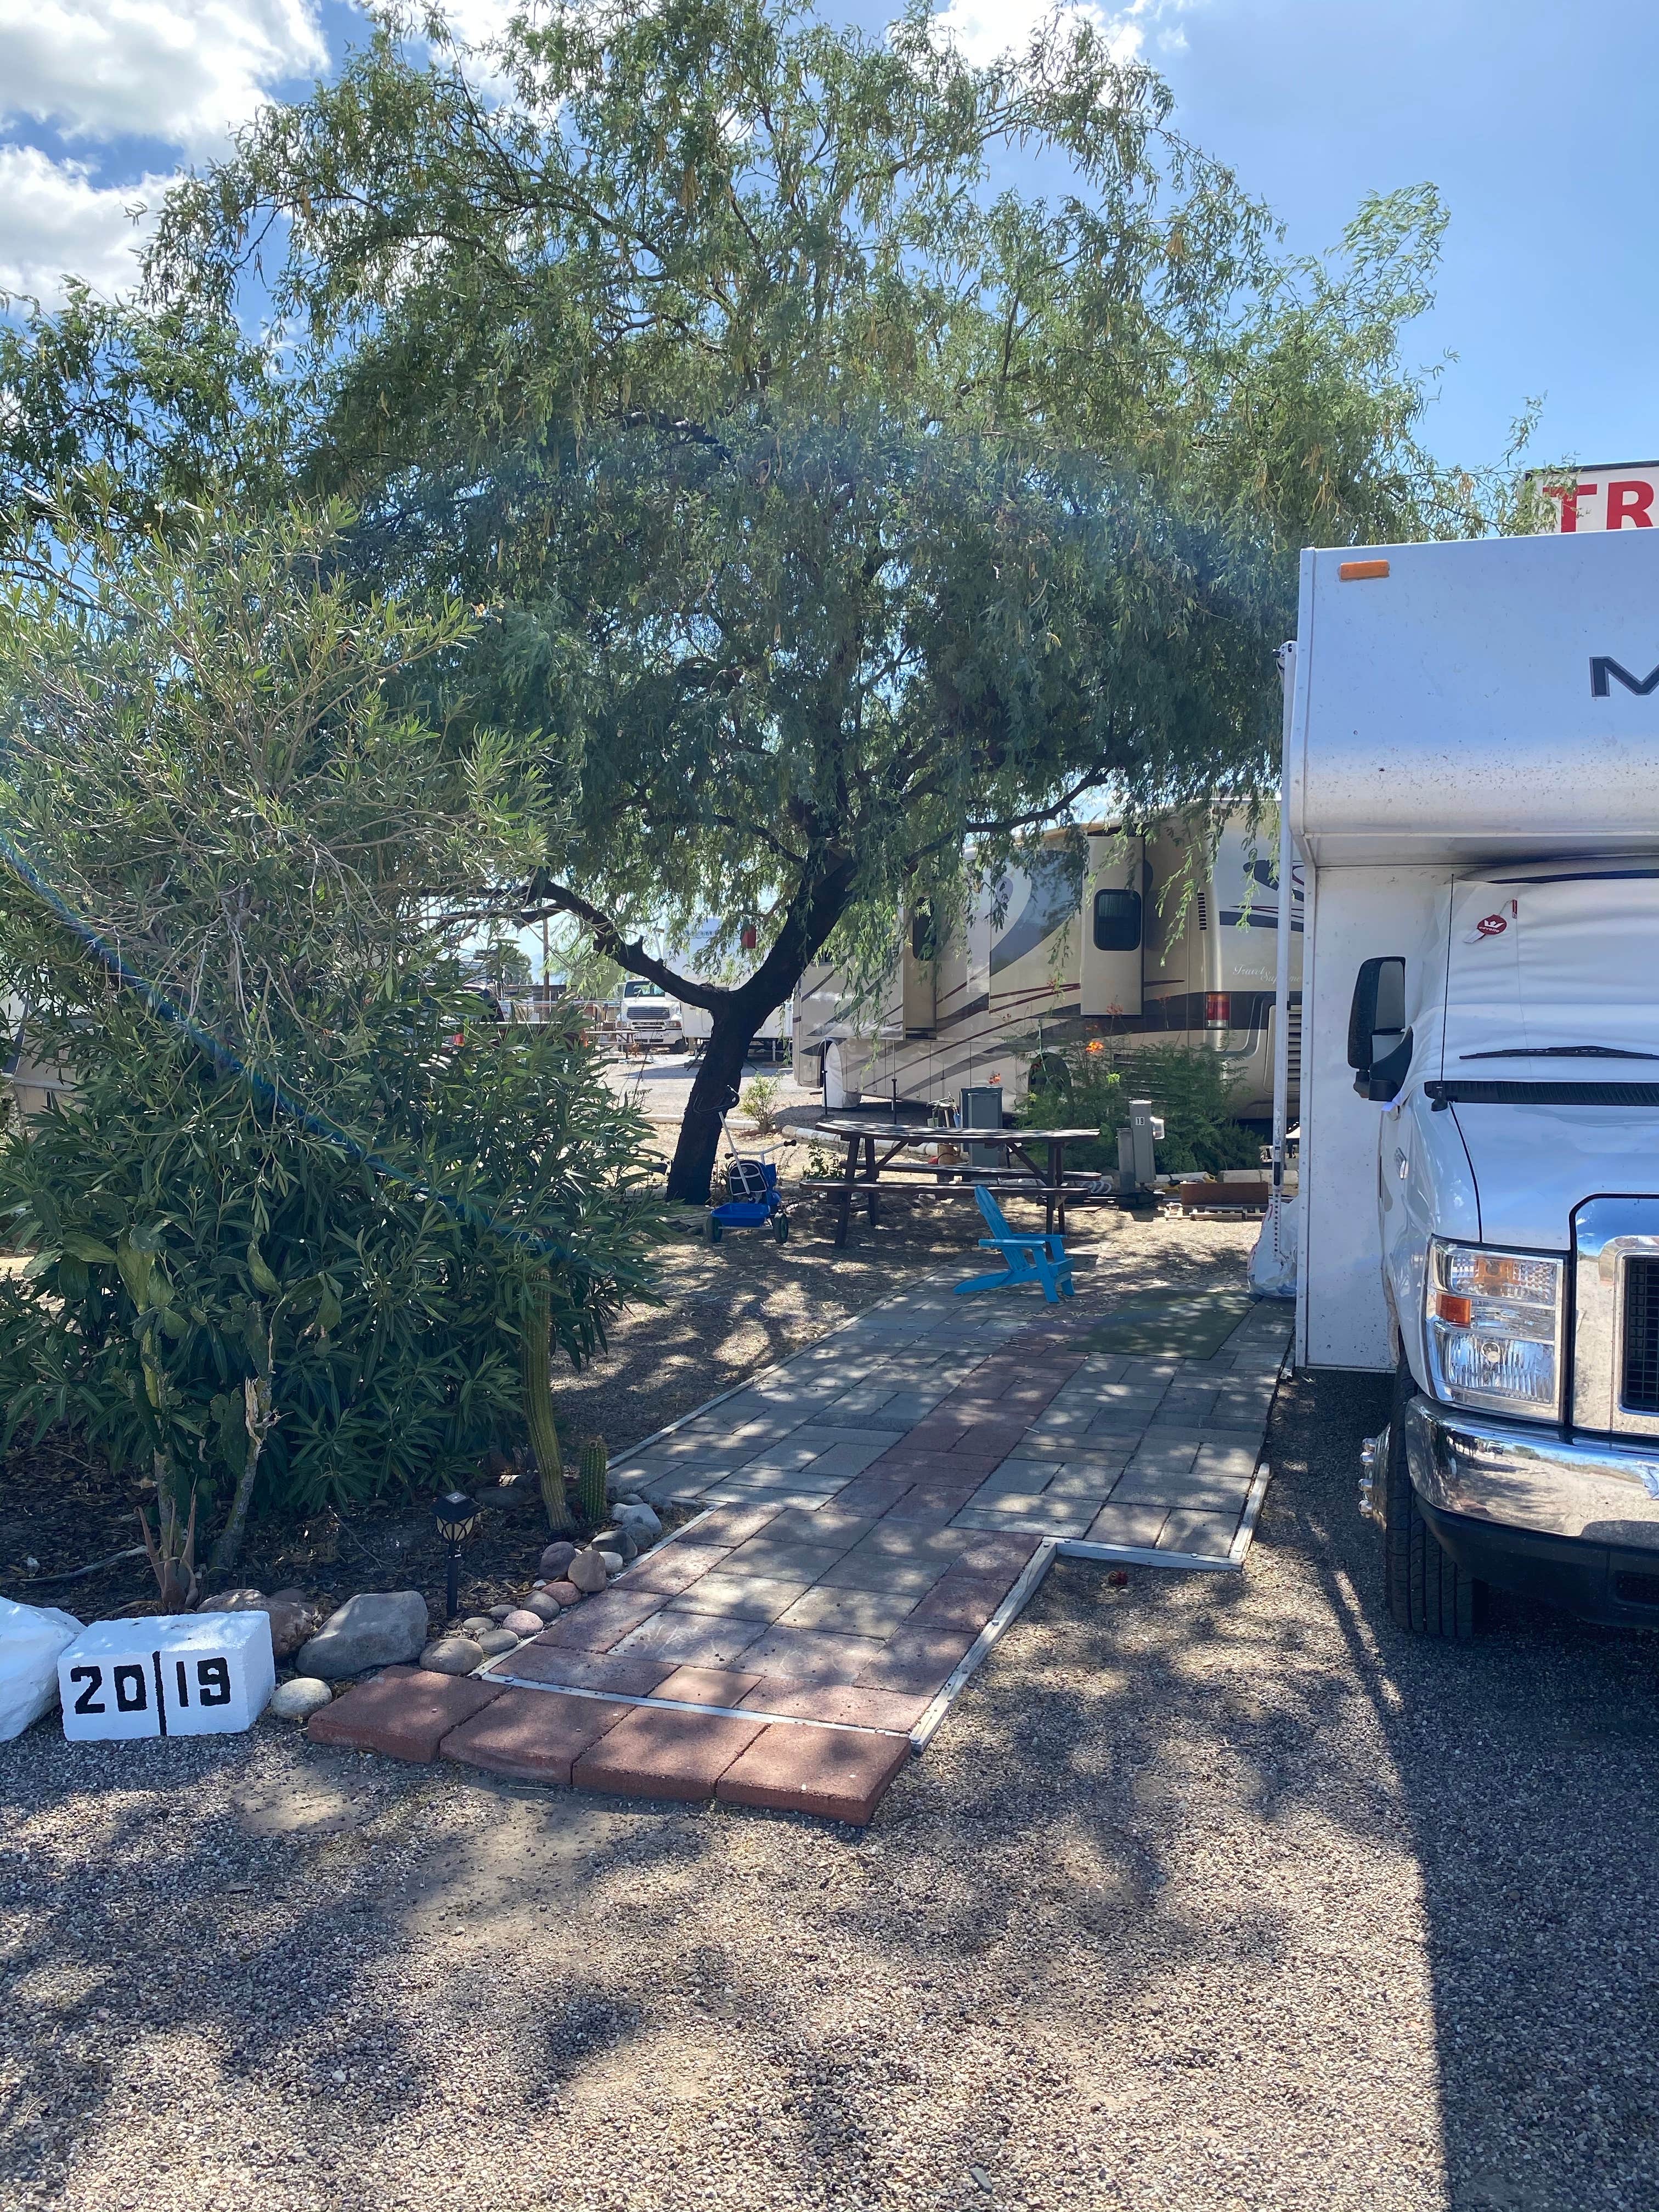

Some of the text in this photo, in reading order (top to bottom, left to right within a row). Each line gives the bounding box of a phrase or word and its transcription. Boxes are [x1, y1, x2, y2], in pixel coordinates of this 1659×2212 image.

[1542, 481, 1655, 533] TR
[1233, 964, 1265, 975] Travel
[1260, 970, 1300, 984] Supme
